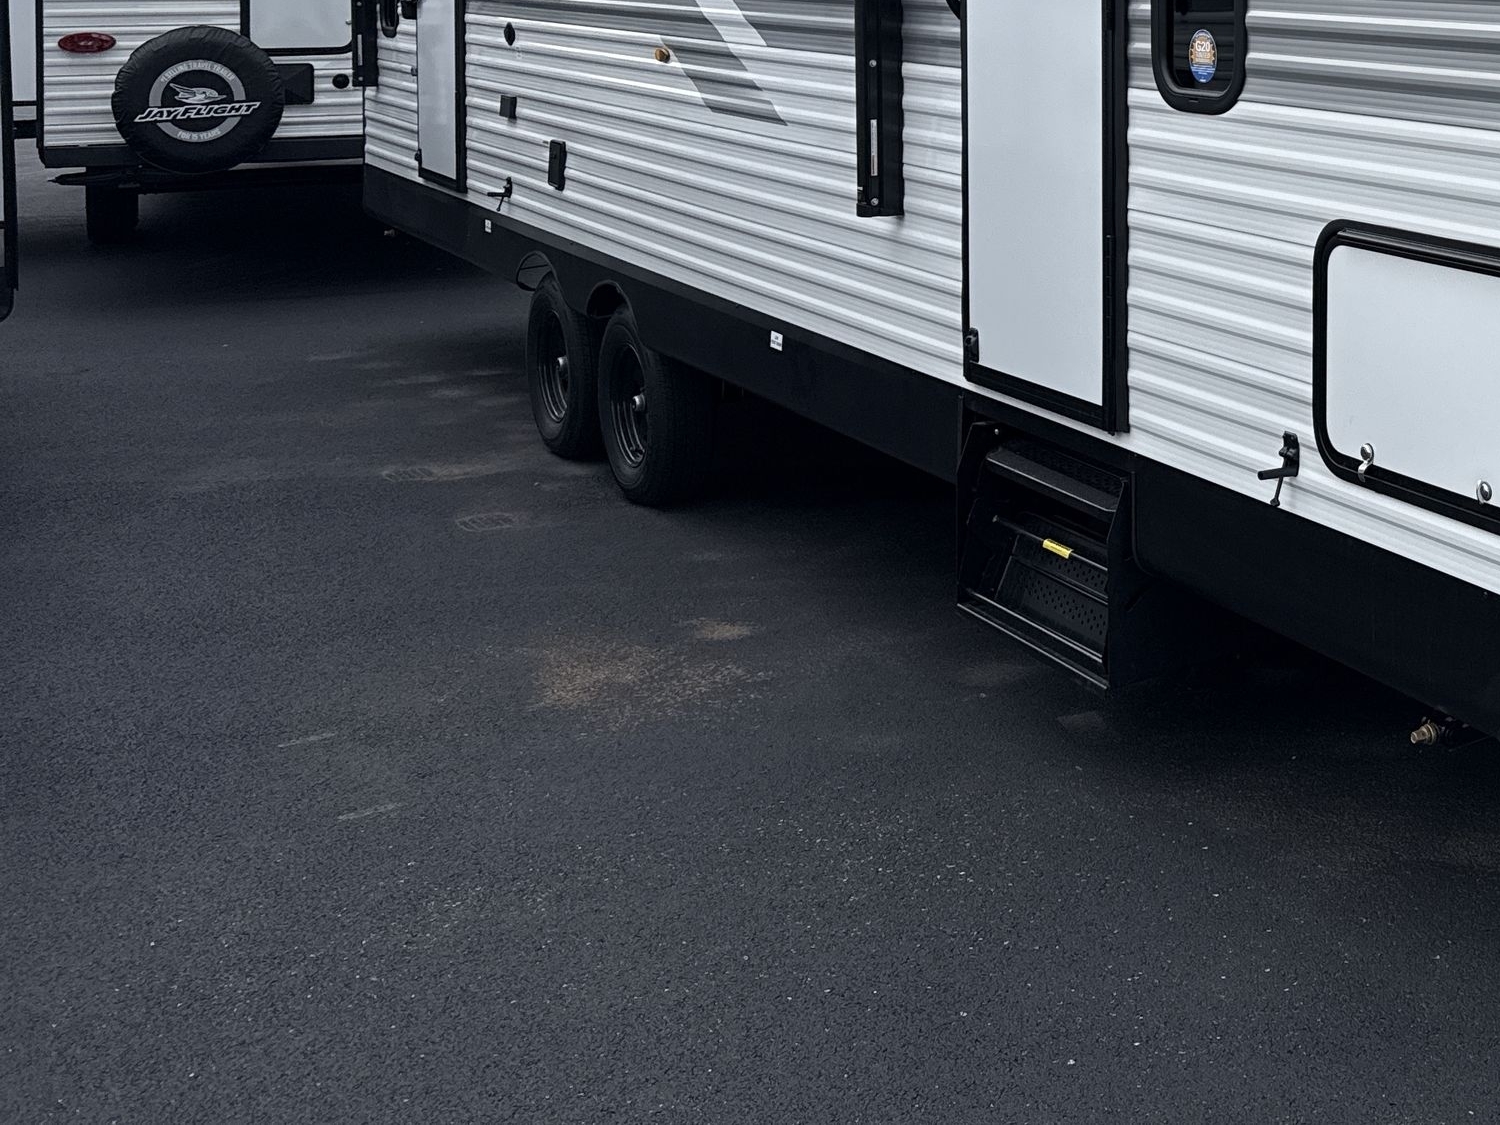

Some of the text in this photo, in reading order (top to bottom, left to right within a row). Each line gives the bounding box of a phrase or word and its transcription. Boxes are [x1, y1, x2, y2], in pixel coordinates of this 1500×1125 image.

[1195, 40, 1211, 52] G20
[134, 101, 262, 123] JAY FLIGHT
[199, 128, 222, 140] YEARS
